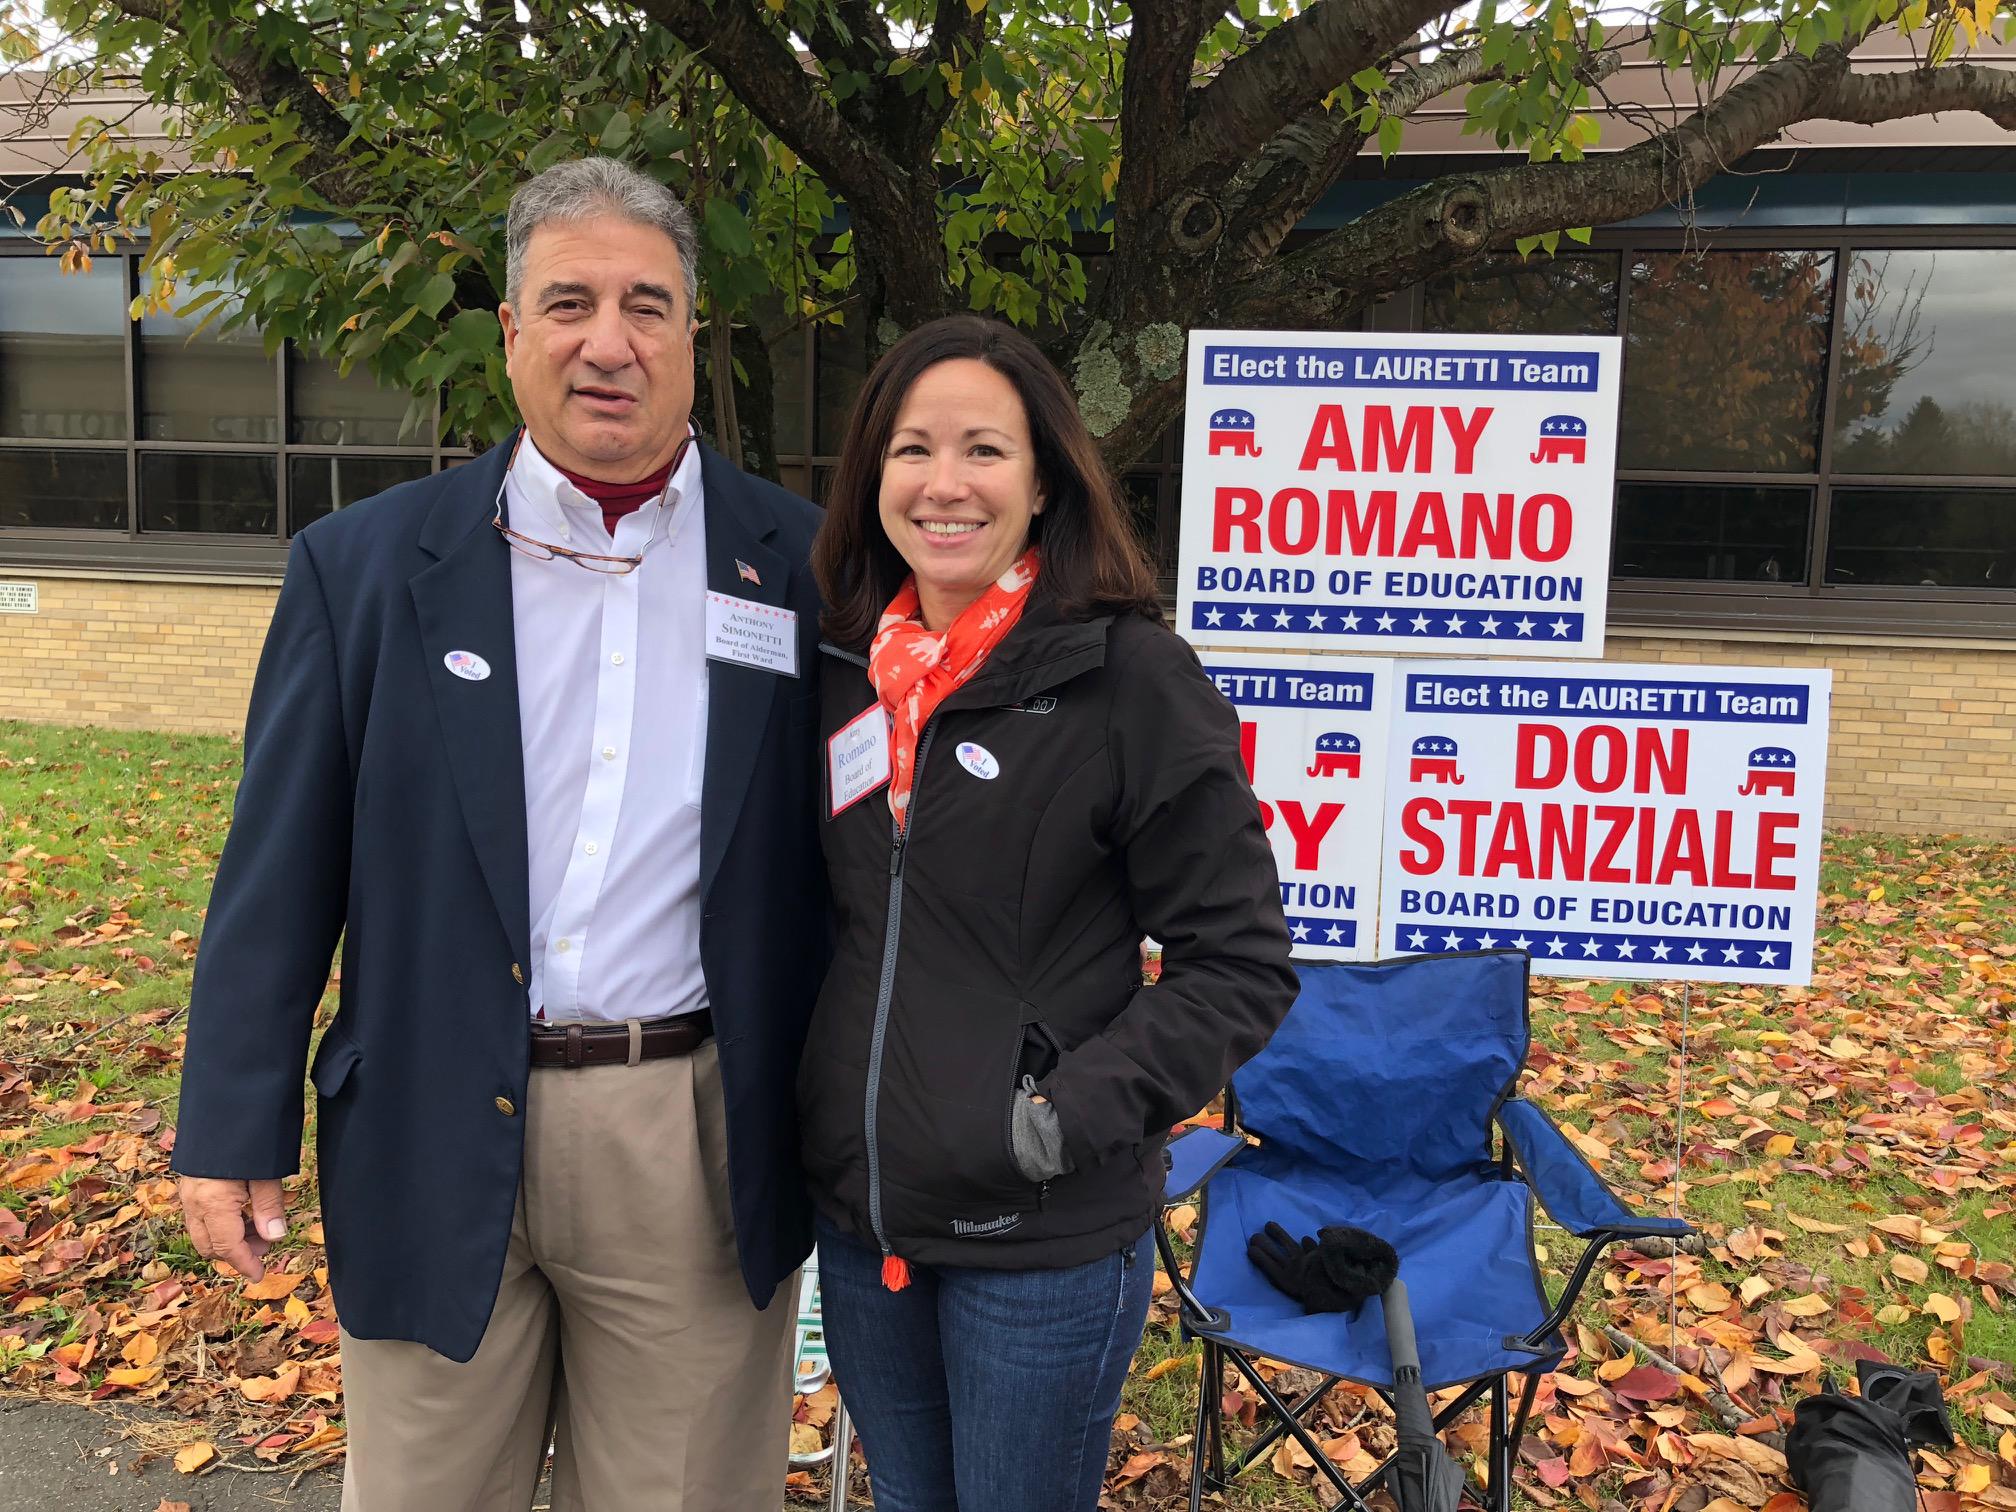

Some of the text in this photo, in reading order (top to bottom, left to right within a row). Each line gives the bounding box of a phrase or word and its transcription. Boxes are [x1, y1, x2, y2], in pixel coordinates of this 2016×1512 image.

[1212, 352, 1589, 384] Elect the LAURETTI Team
[1298, 404, 1494, 474] AMY
[1212, 486, 1573, 563] ROMANO
[1196, 566, 1584, 602] BOARD OF EDUCATION
[721, 623, 783, 646] SIMONETTI
[730, 613, 775, 630] ANTHONY
[715, 636, 739, 648] Board
[732, 649, 773, 665] First Ward
[460, 666, 481, 679] Voted
[1285, 677, 1364, 703] Team
[1414, 681, 1799, 716] Elect the LAURETTI Team
[837, 735, 877, 769] Romano
[1515, 723, 1690, 795] DON
[845, 758, 873, 785] Board of
[969, 759, 990, 779] Voted
[843, 775, 875, 802] Education
[1398, 796, 1800, 891] STANZIALE
[1399, 889, 1792, 931] BOARD OF EDUCATION
